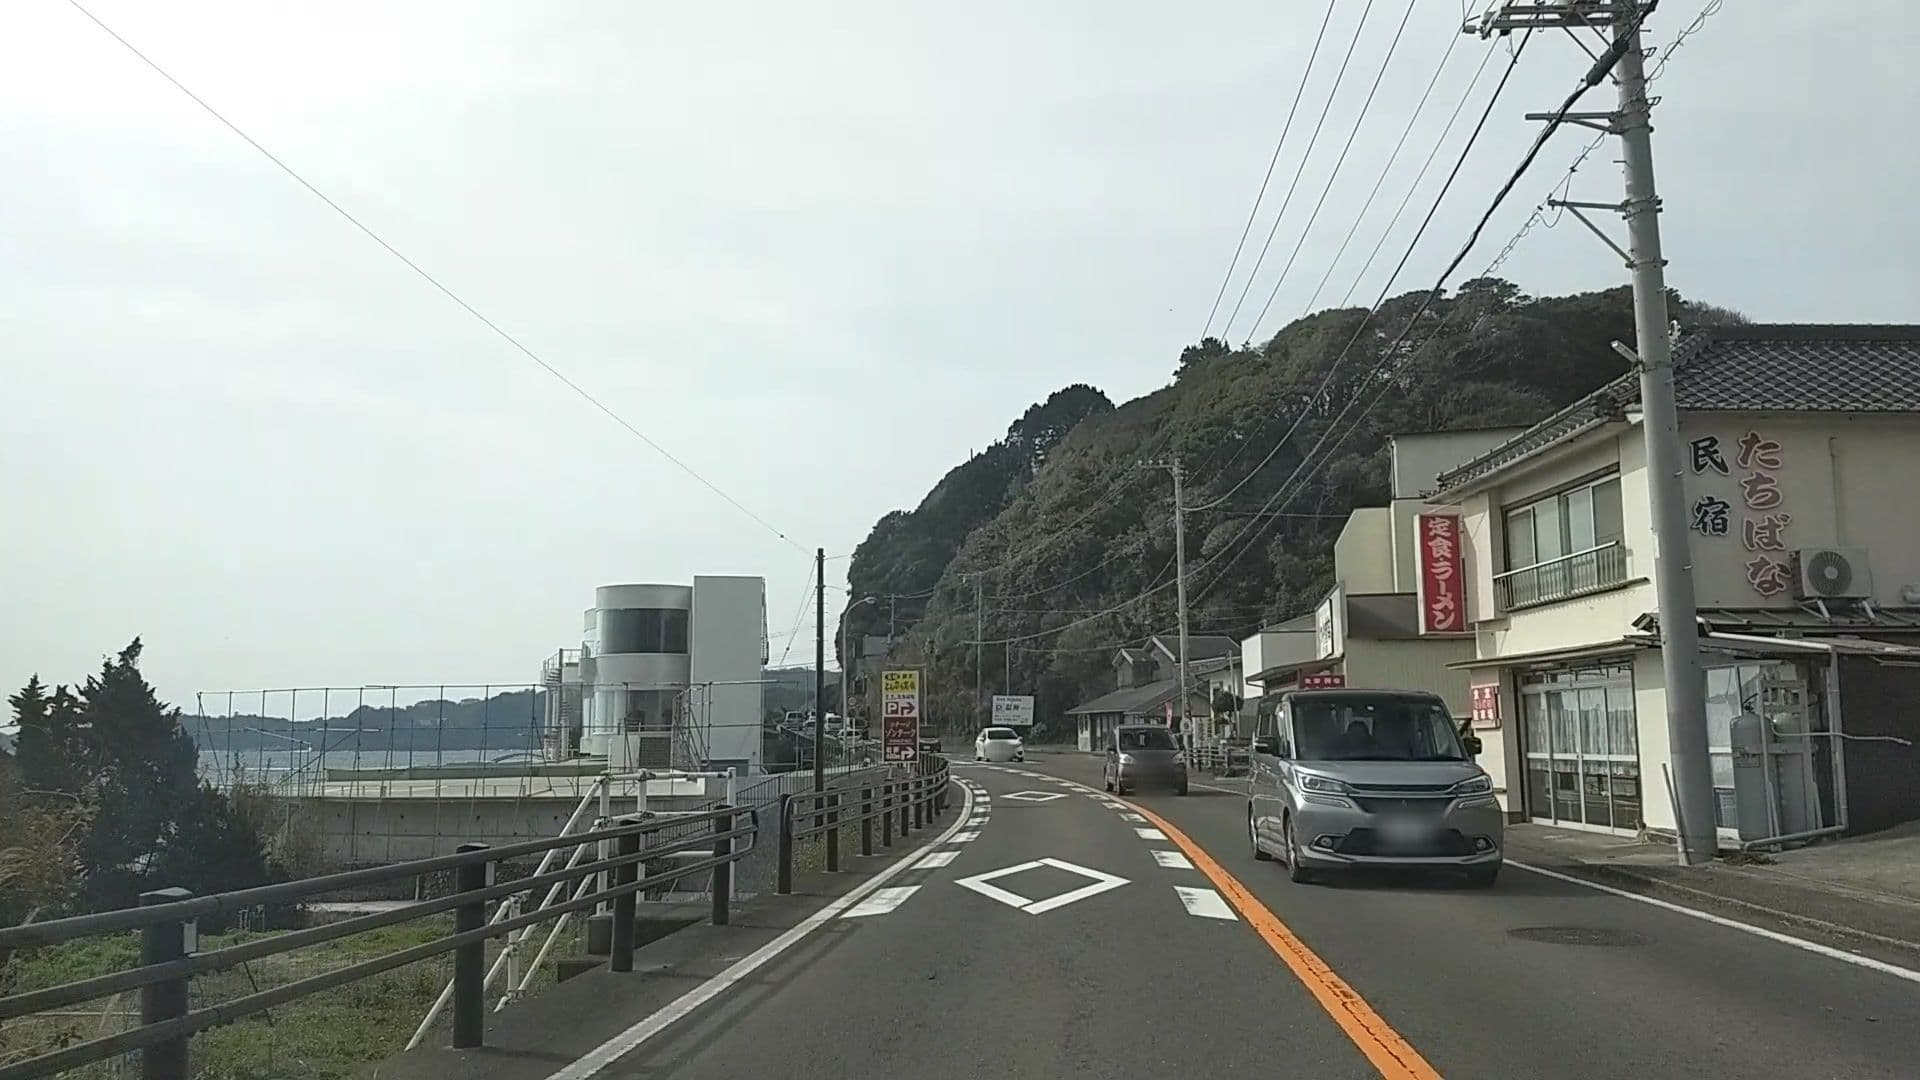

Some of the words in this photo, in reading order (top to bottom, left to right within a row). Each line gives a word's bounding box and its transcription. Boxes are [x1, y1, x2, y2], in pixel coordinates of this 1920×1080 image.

[1689, 434, 1731, 536] 民宿
[1737, 431, 1792, 597] たちばな
